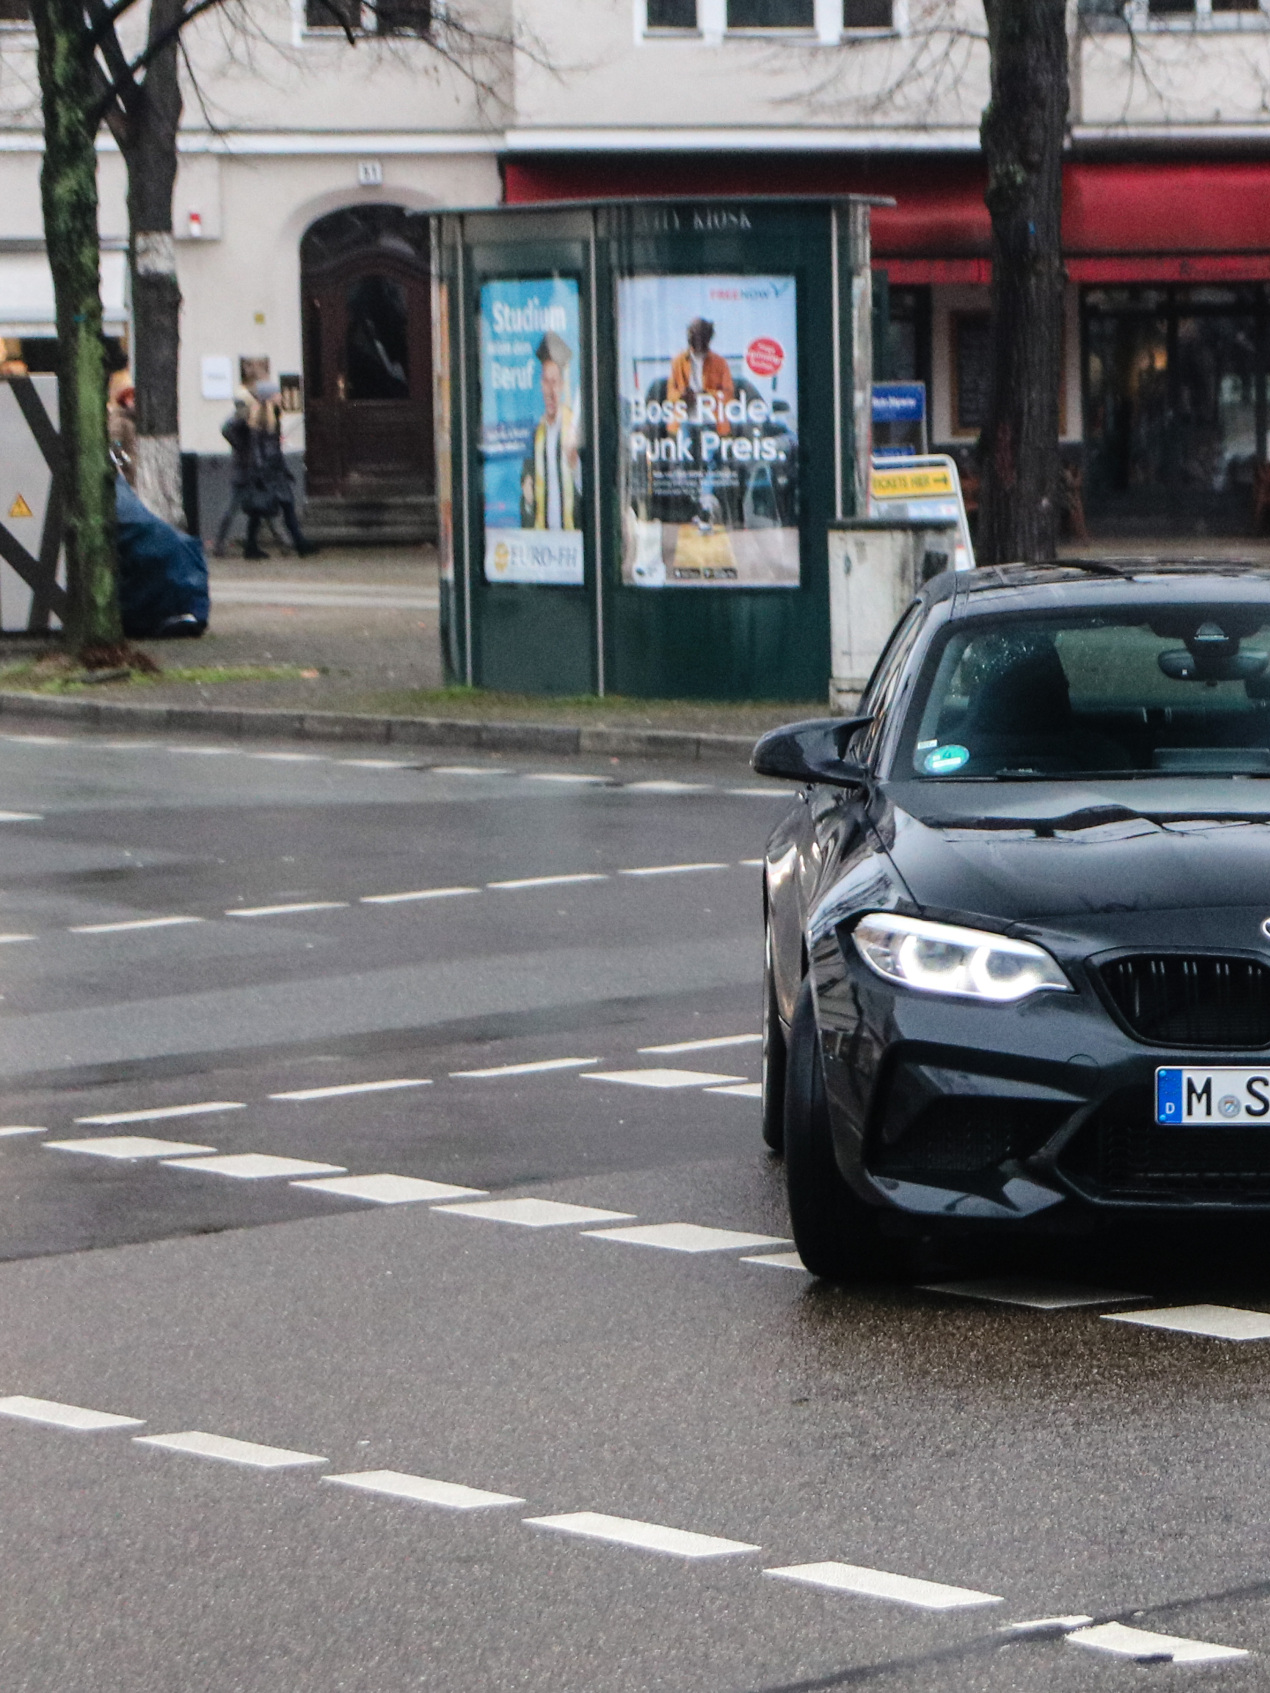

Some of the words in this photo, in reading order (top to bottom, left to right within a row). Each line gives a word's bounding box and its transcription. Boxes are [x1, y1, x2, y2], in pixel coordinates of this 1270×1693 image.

[693, 208, 752, 230] KIOSK
[492, 296, 567, 333] Studium
[491, 359, 535, 389] Beruf
[630, 400, 688, 424] Boss
[631, 429, 694, 462] Punk
[701, 427, 786, 462] Preis.
[1165, 1101, 1176, 1114] D
[1186, 1076, 1213, 1117] M
